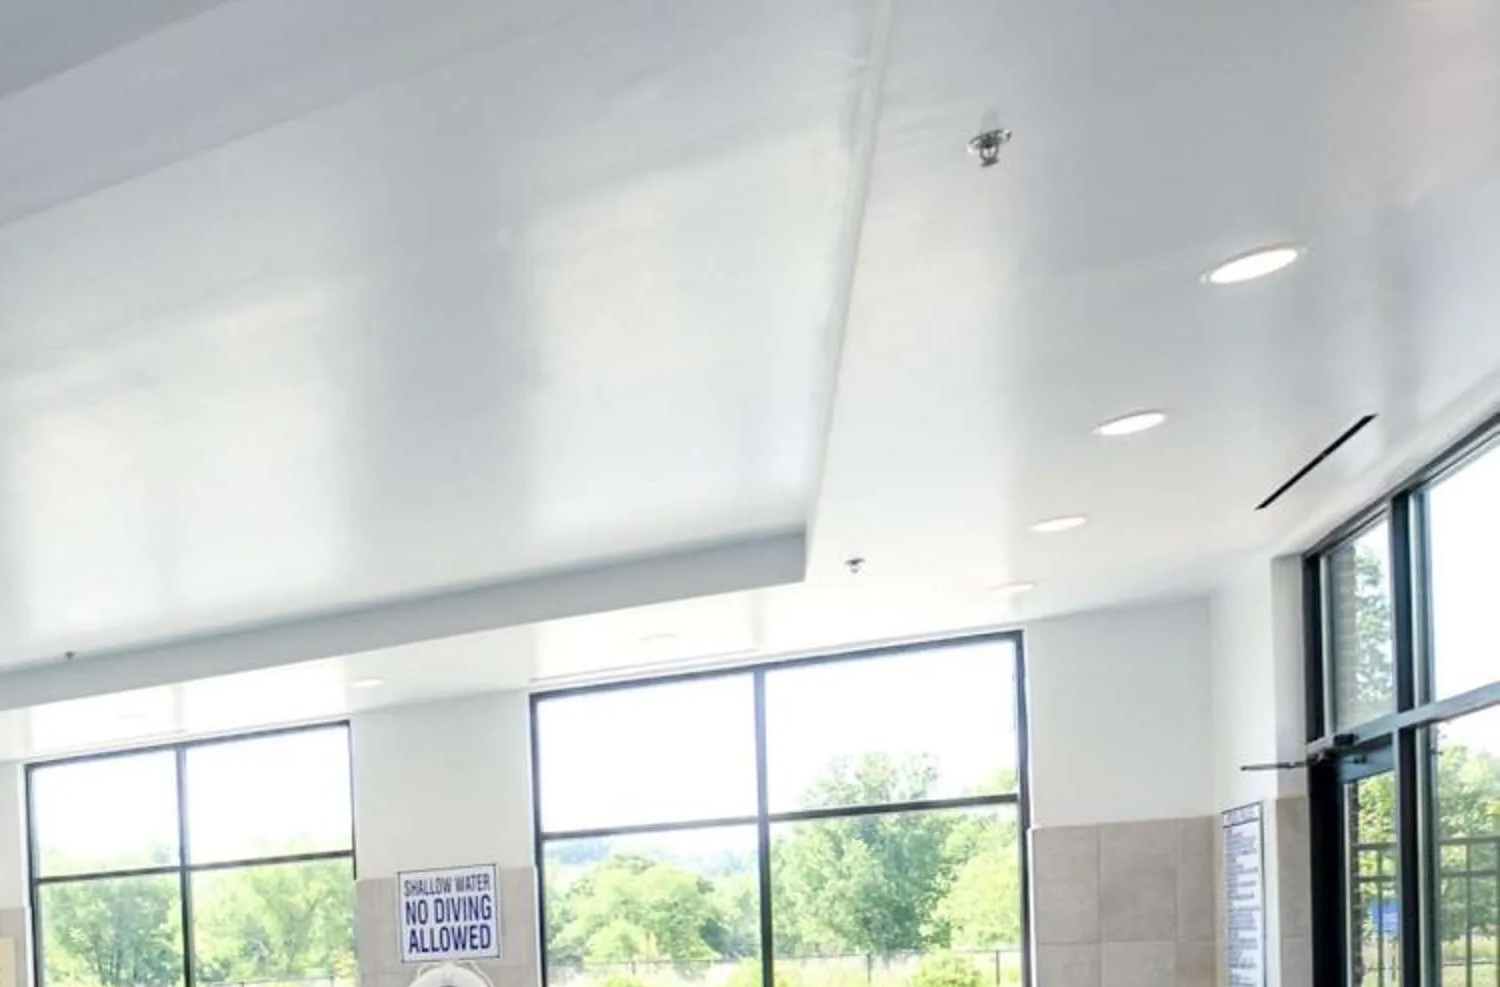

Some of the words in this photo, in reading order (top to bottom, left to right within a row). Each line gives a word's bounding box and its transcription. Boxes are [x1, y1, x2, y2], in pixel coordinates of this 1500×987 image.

[404, 877, 452, 897] SHALLOW
[455, 873, 490, 892] WATER
[405, 899, 428, 925] NO
[434, 894, 492, 924] DIVING
[409, 923, 491, 954] ALLOWED
